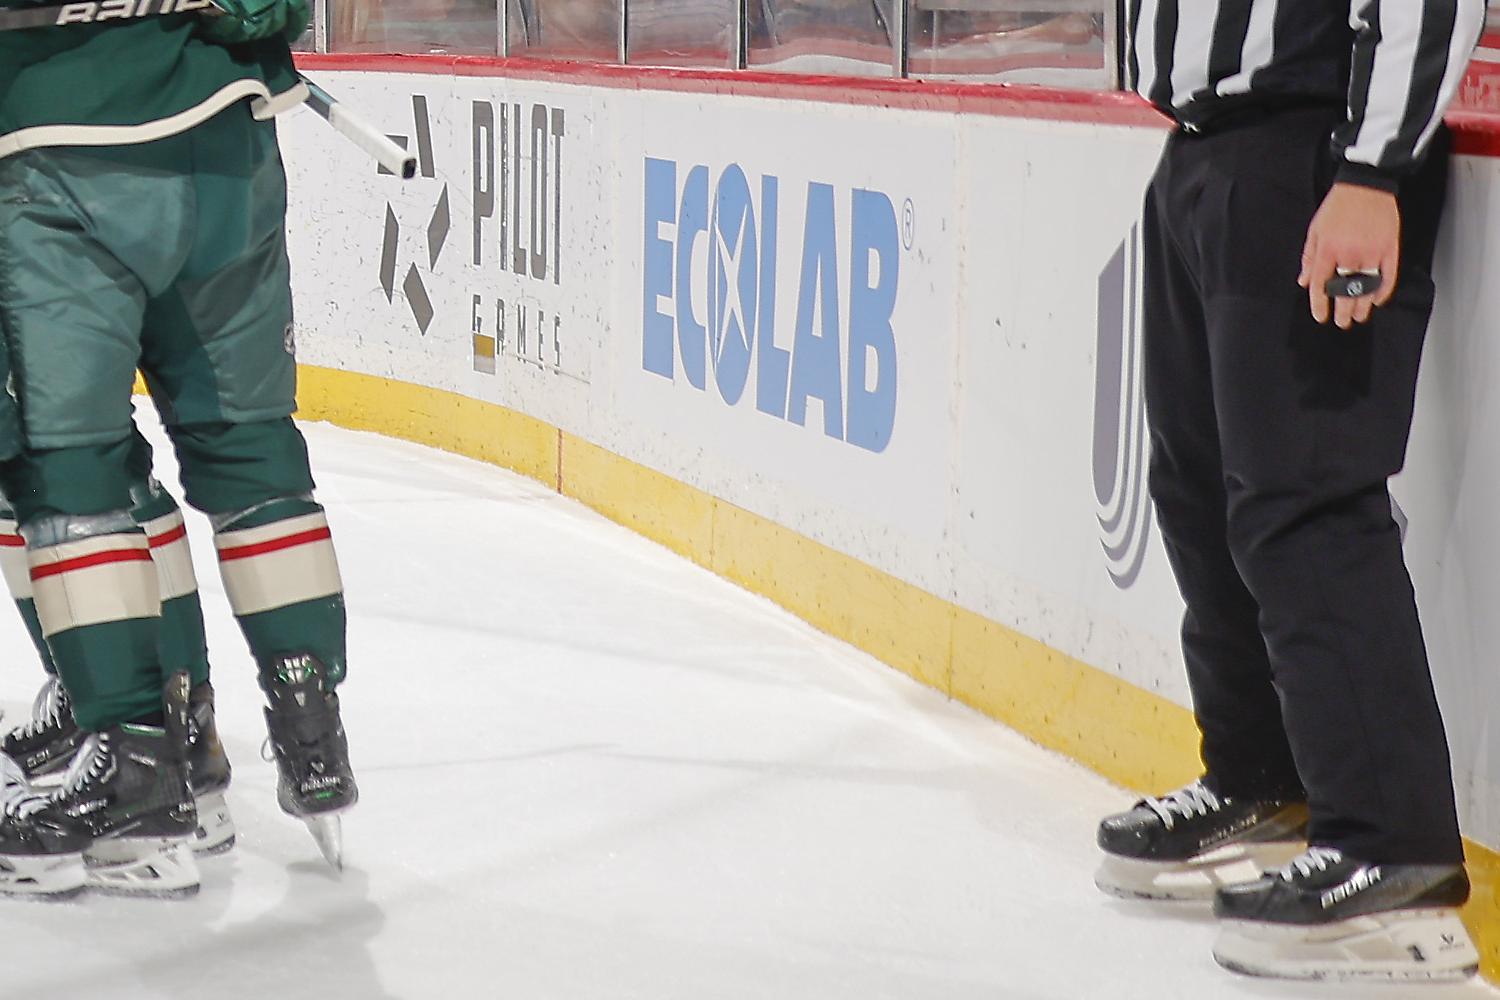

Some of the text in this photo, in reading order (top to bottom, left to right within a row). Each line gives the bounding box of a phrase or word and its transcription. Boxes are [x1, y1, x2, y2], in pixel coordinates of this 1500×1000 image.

[471, 100, 565, 286] PILOT
[471, 294, 561, 375] GAMES
[642, 157, 899, 453] ECOLAB
